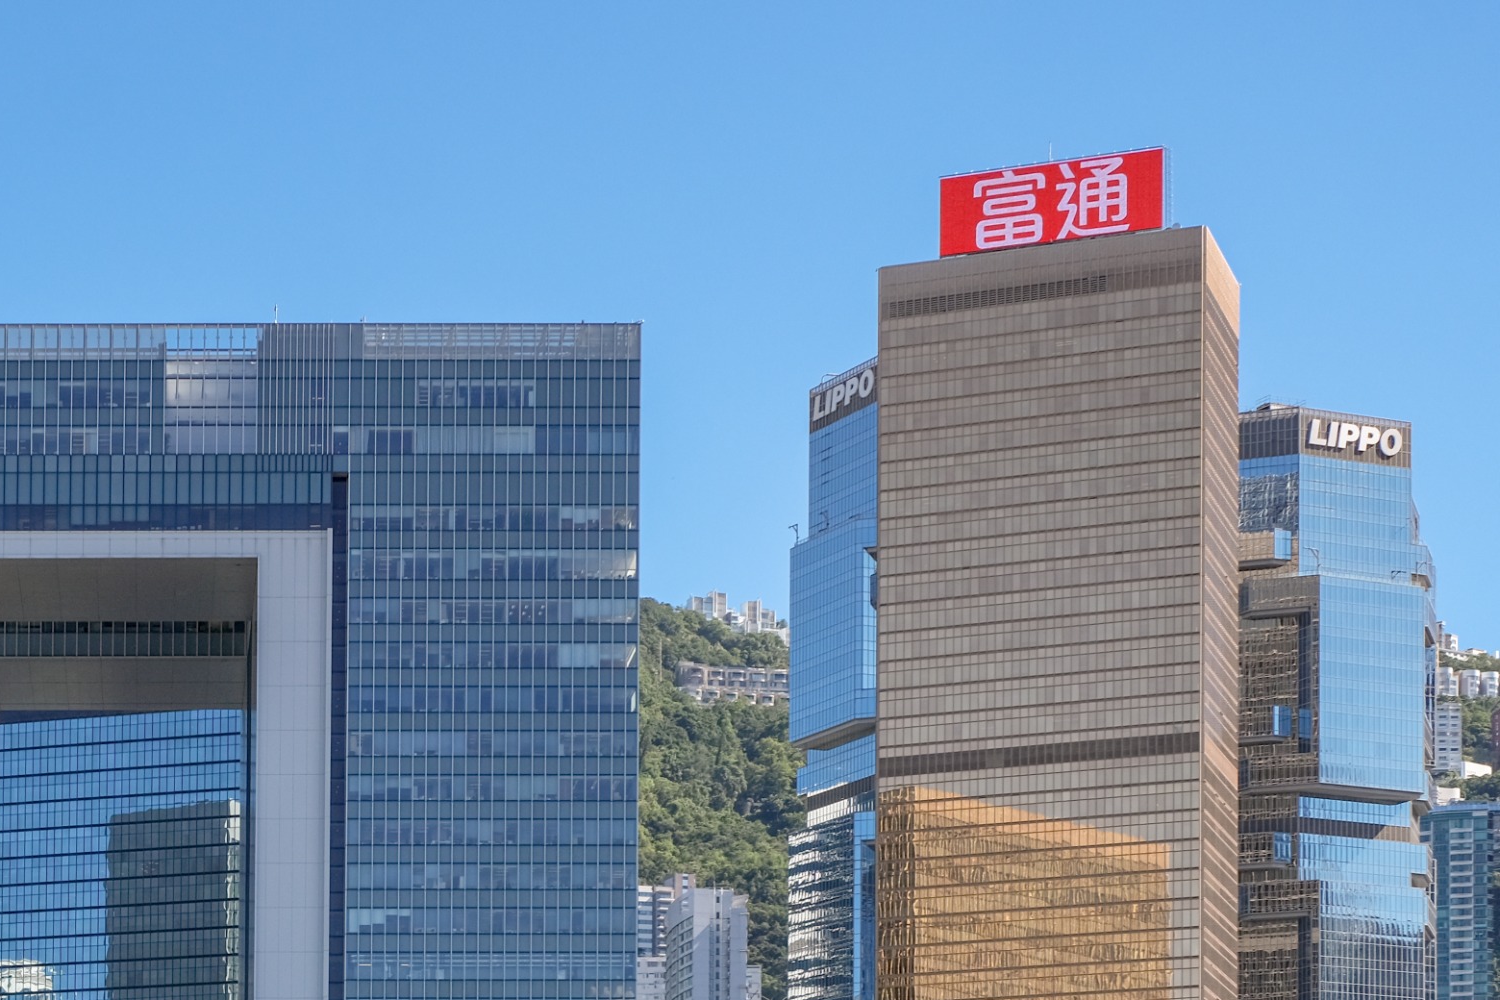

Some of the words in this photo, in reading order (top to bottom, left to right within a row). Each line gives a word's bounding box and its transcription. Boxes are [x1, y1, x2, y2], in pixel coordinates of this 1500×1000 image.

[973, 157, 1130, 249] 富通
[812, 368, 875, 421] LIPPO
[1308, 418, 1403, 456] LIPPO
